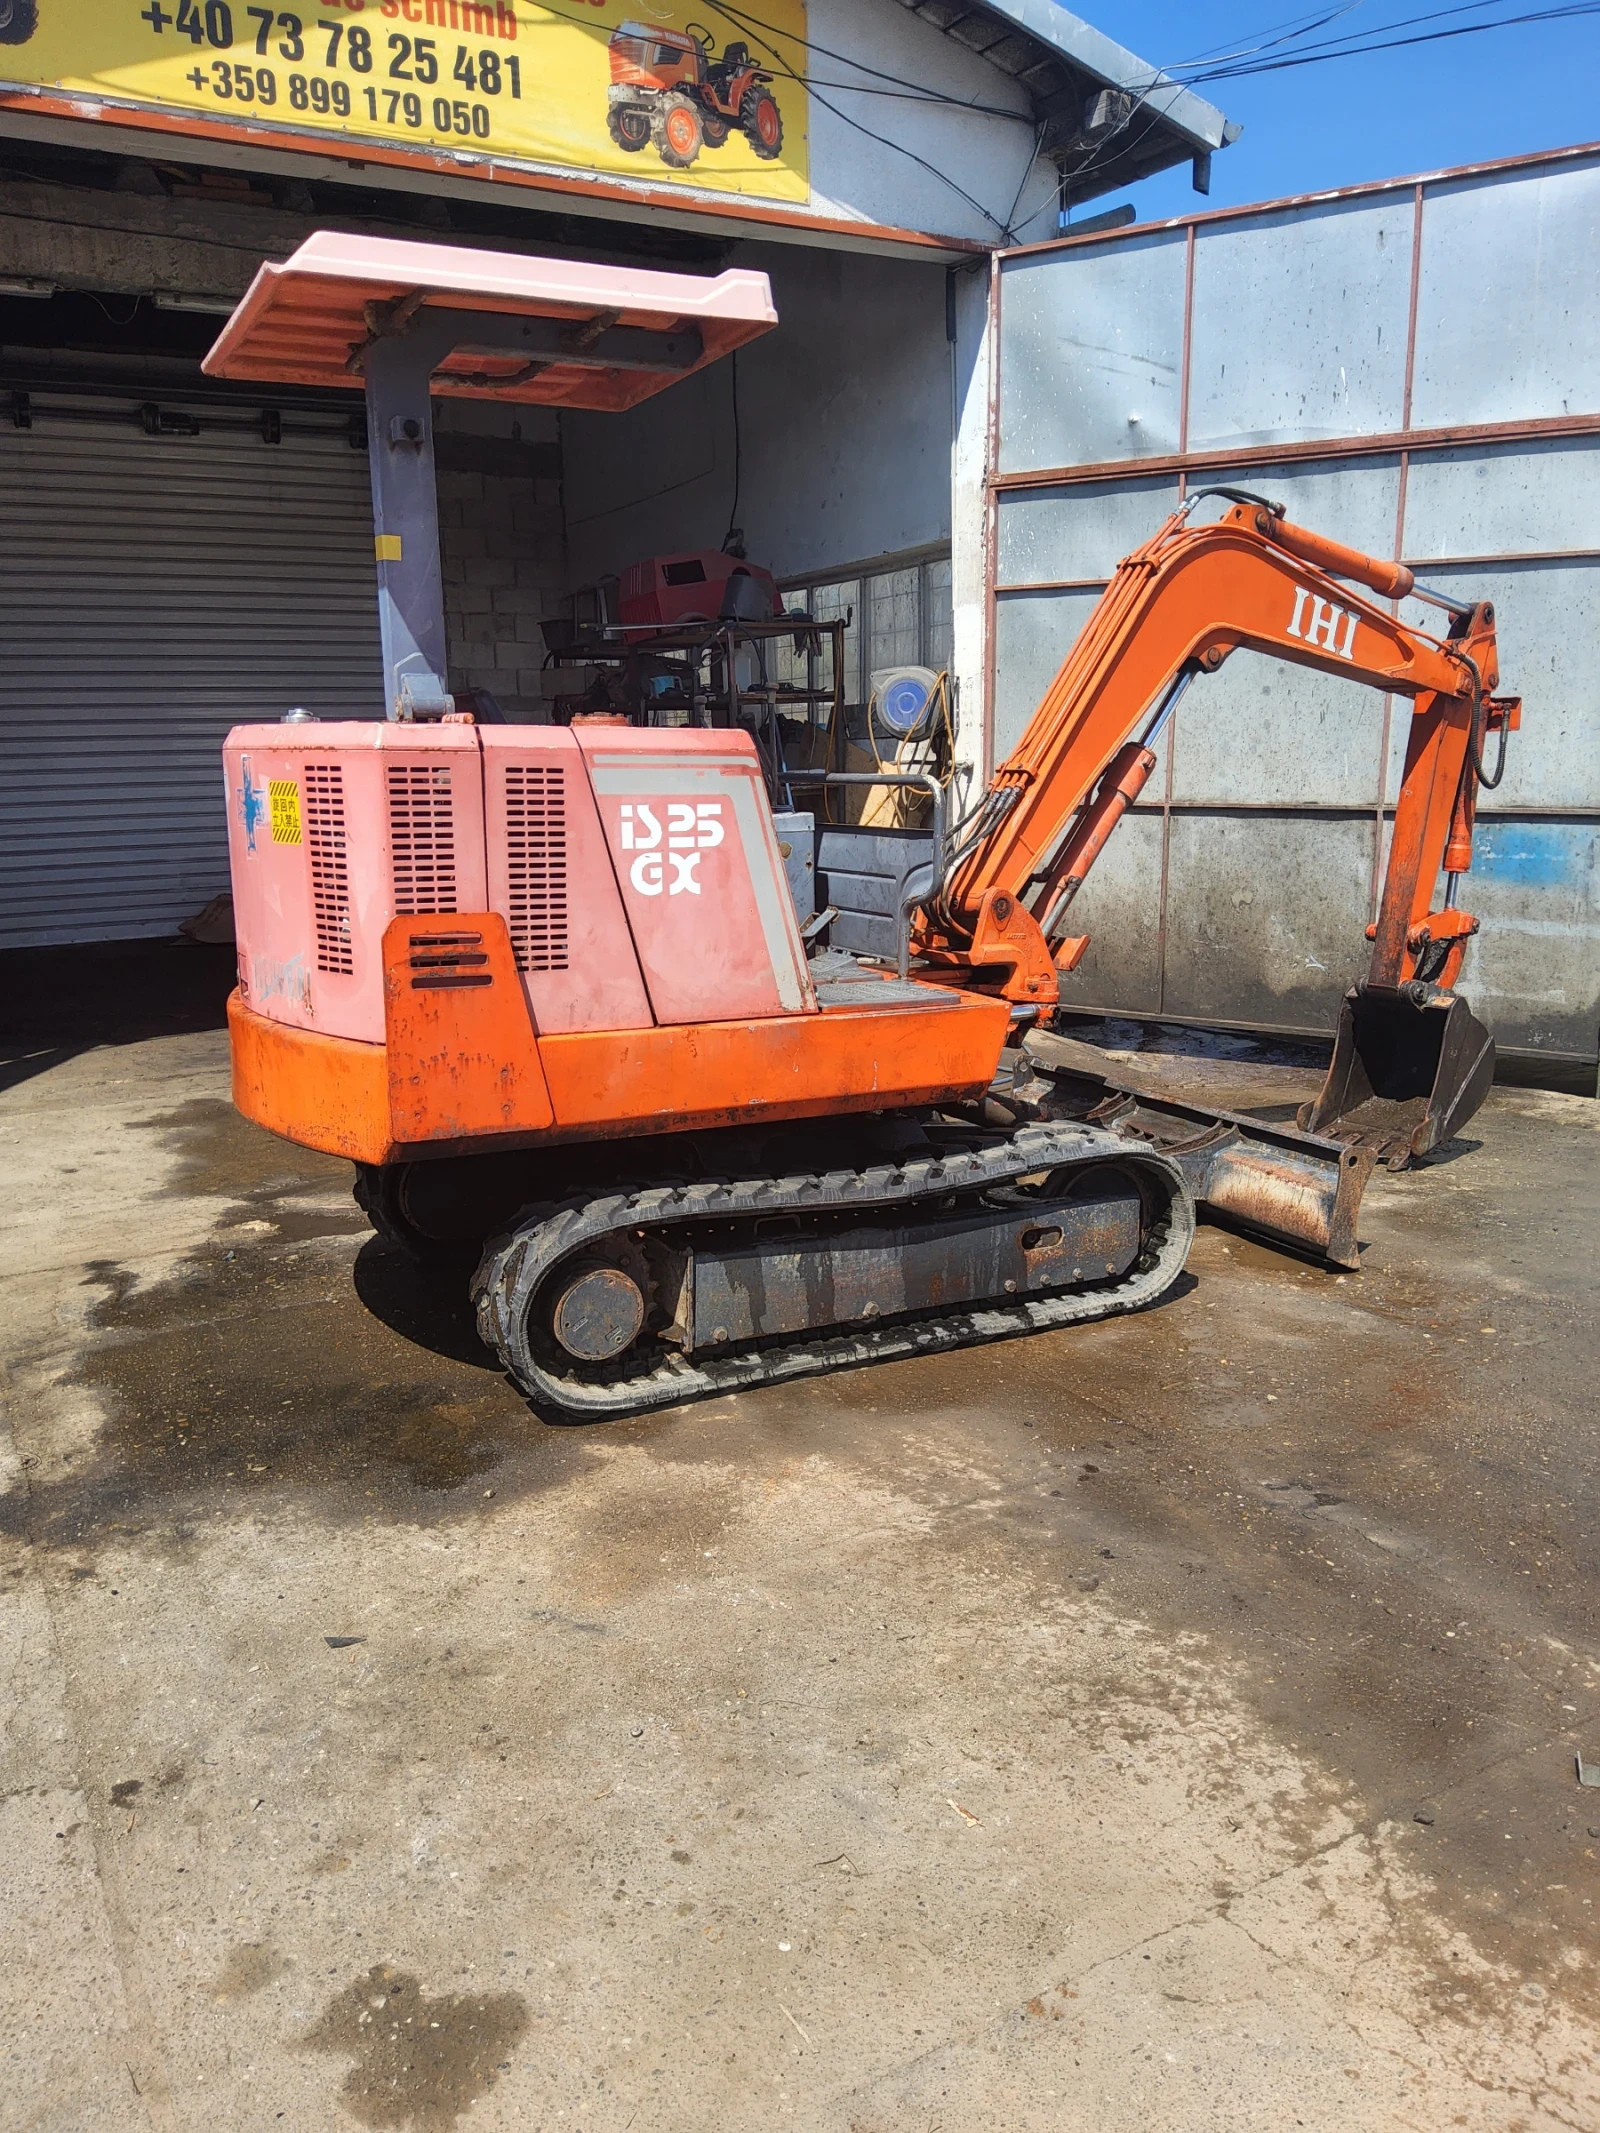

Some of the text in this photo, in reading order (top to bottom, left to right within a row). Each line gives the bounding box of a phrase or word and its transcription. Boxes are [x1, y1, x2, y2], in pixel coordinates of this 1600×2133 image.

[141, 0, 521, 100] +40 73 78 25 481
[186, 60, 490, 139] +359 899 179 050
[1286, 585, 1361, 660] IHI
[630, 852, 701, 896] GX
